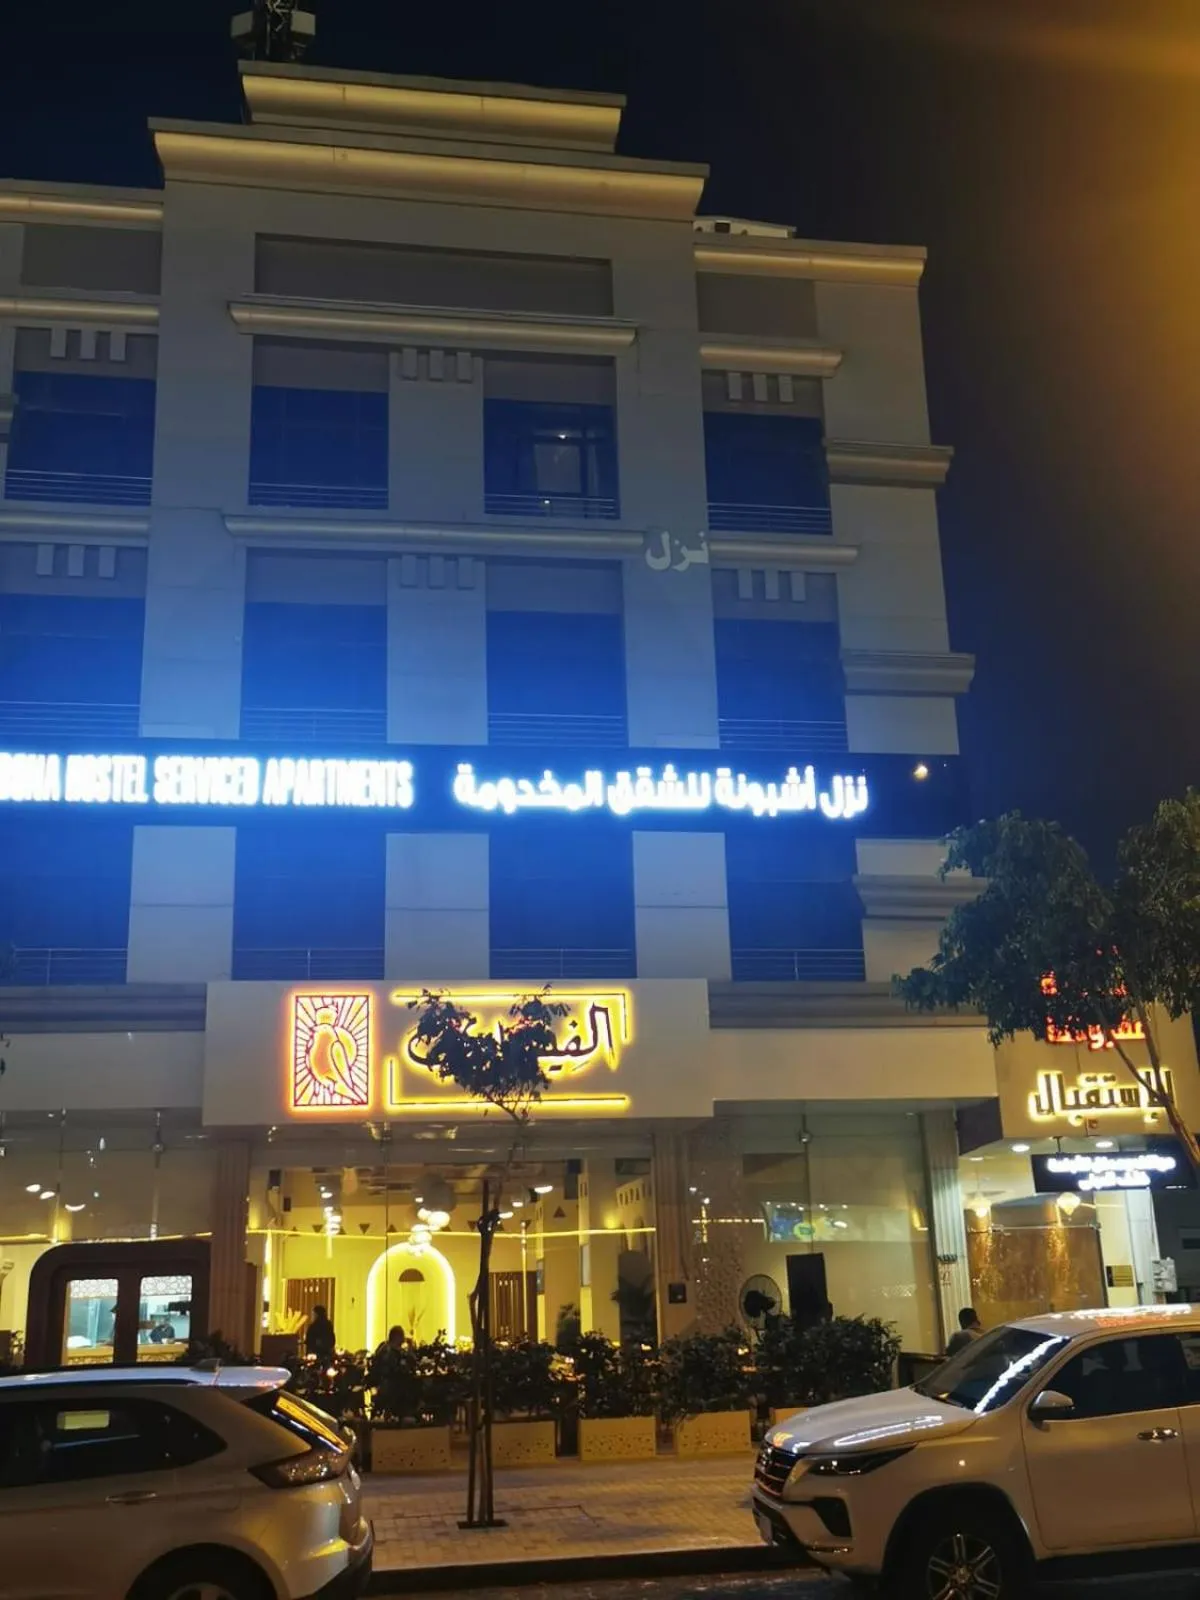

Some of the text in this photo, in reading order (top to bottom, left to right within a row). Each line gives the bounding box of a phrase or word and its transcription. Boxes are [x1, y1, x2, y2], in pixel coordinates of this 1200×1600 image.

[65, 755, 148, 802] HOSTEL
[263, 758, 413, 807] APARTMENTS
[607, 764, 712, 815] للشقق
[820, 774, 868, 818] نزل
